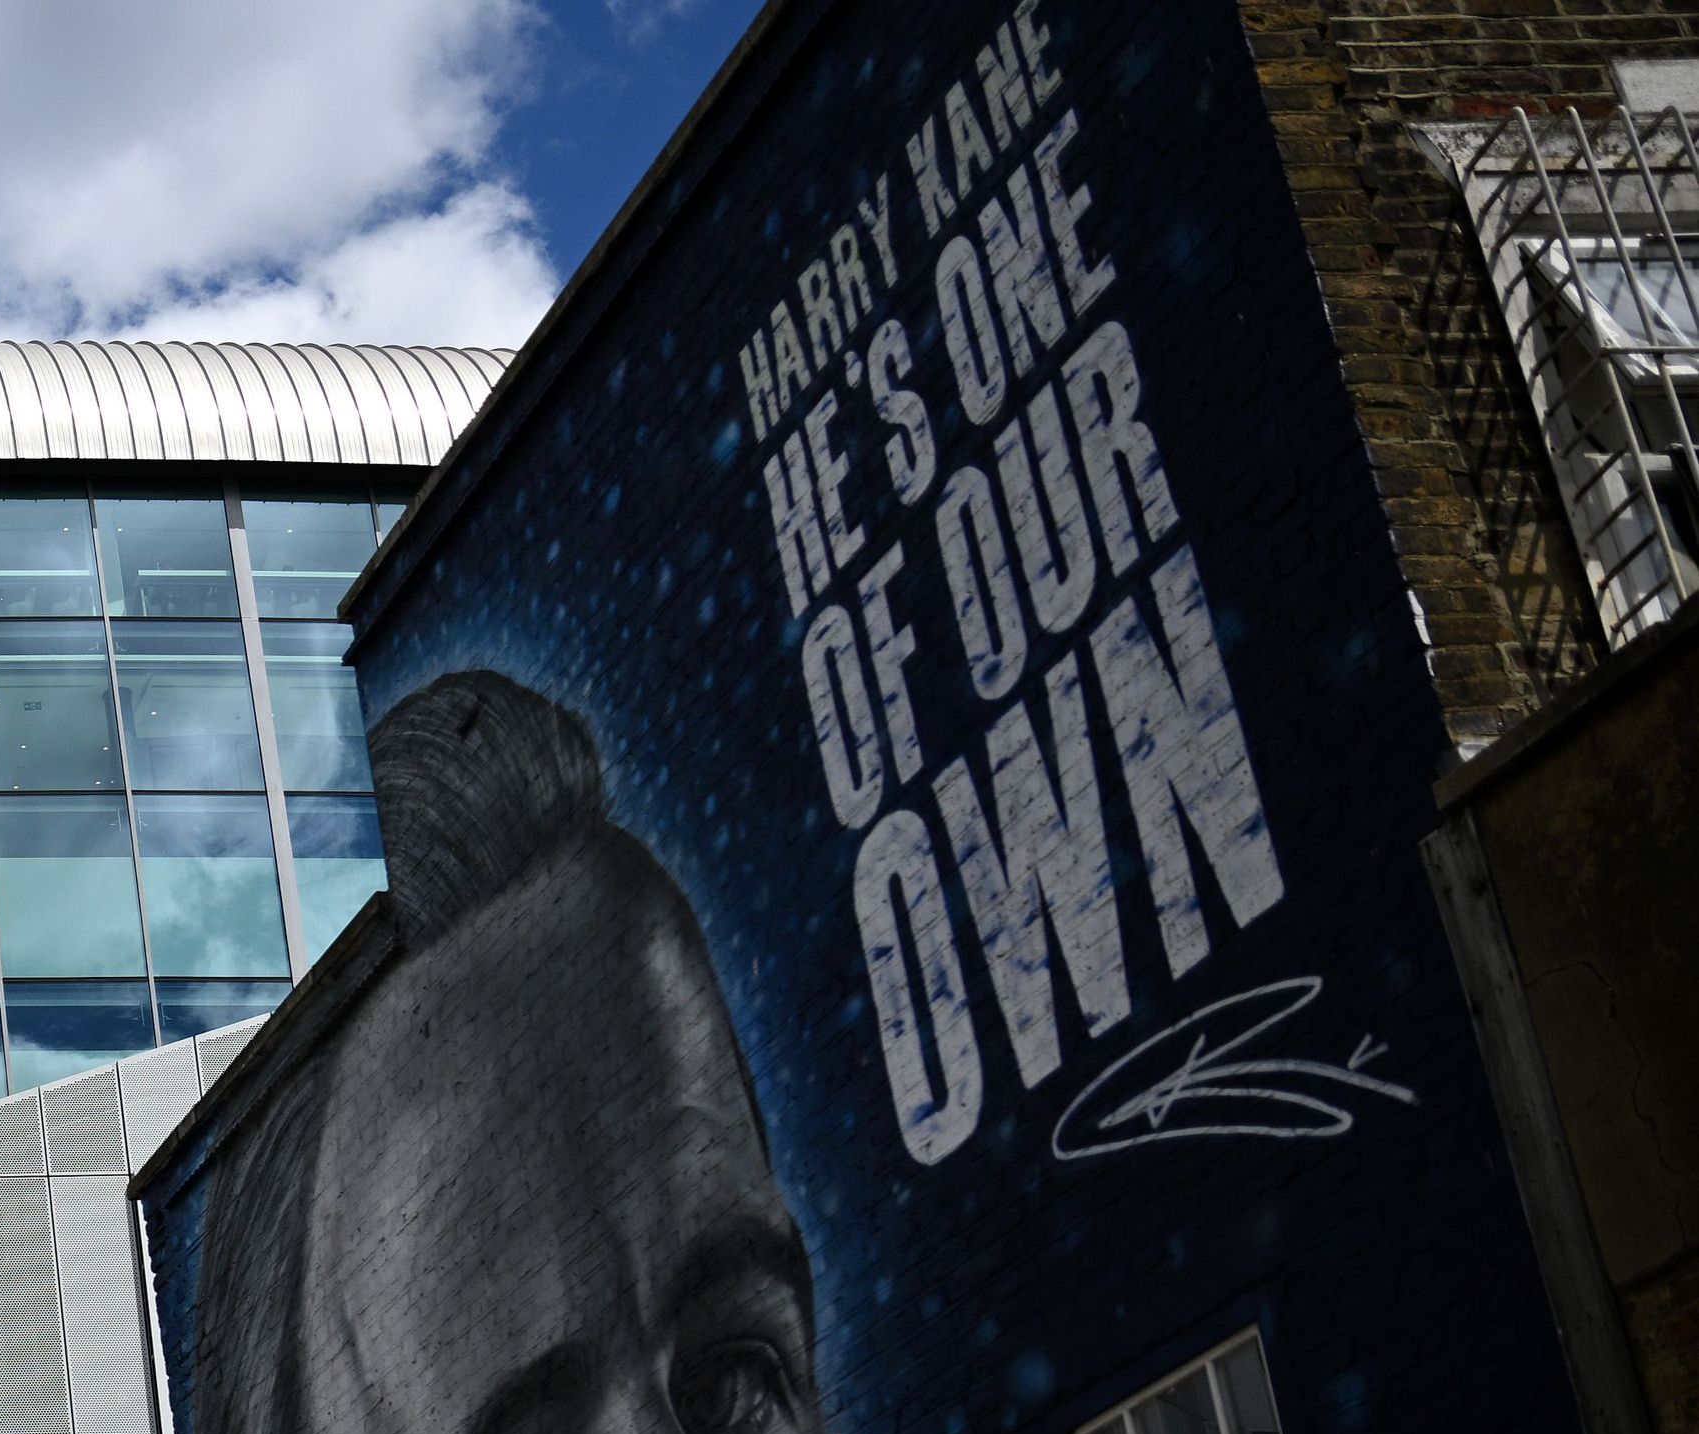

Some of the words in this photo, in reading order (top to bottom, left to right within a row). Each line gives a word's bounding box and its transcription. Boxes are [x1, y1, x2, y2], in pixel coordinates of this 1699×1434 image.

[738, 176, 900, 443] HARRY
[907, 0, 1063, 239] KANE
[763, 319, 935, 617] HE'S
[935, 109, 1117, 426] ONE
[803, 542, 923, 830] OF
[935, 321, 1182, 701] OUR
[853, 542, 1286, 1166] OWN
